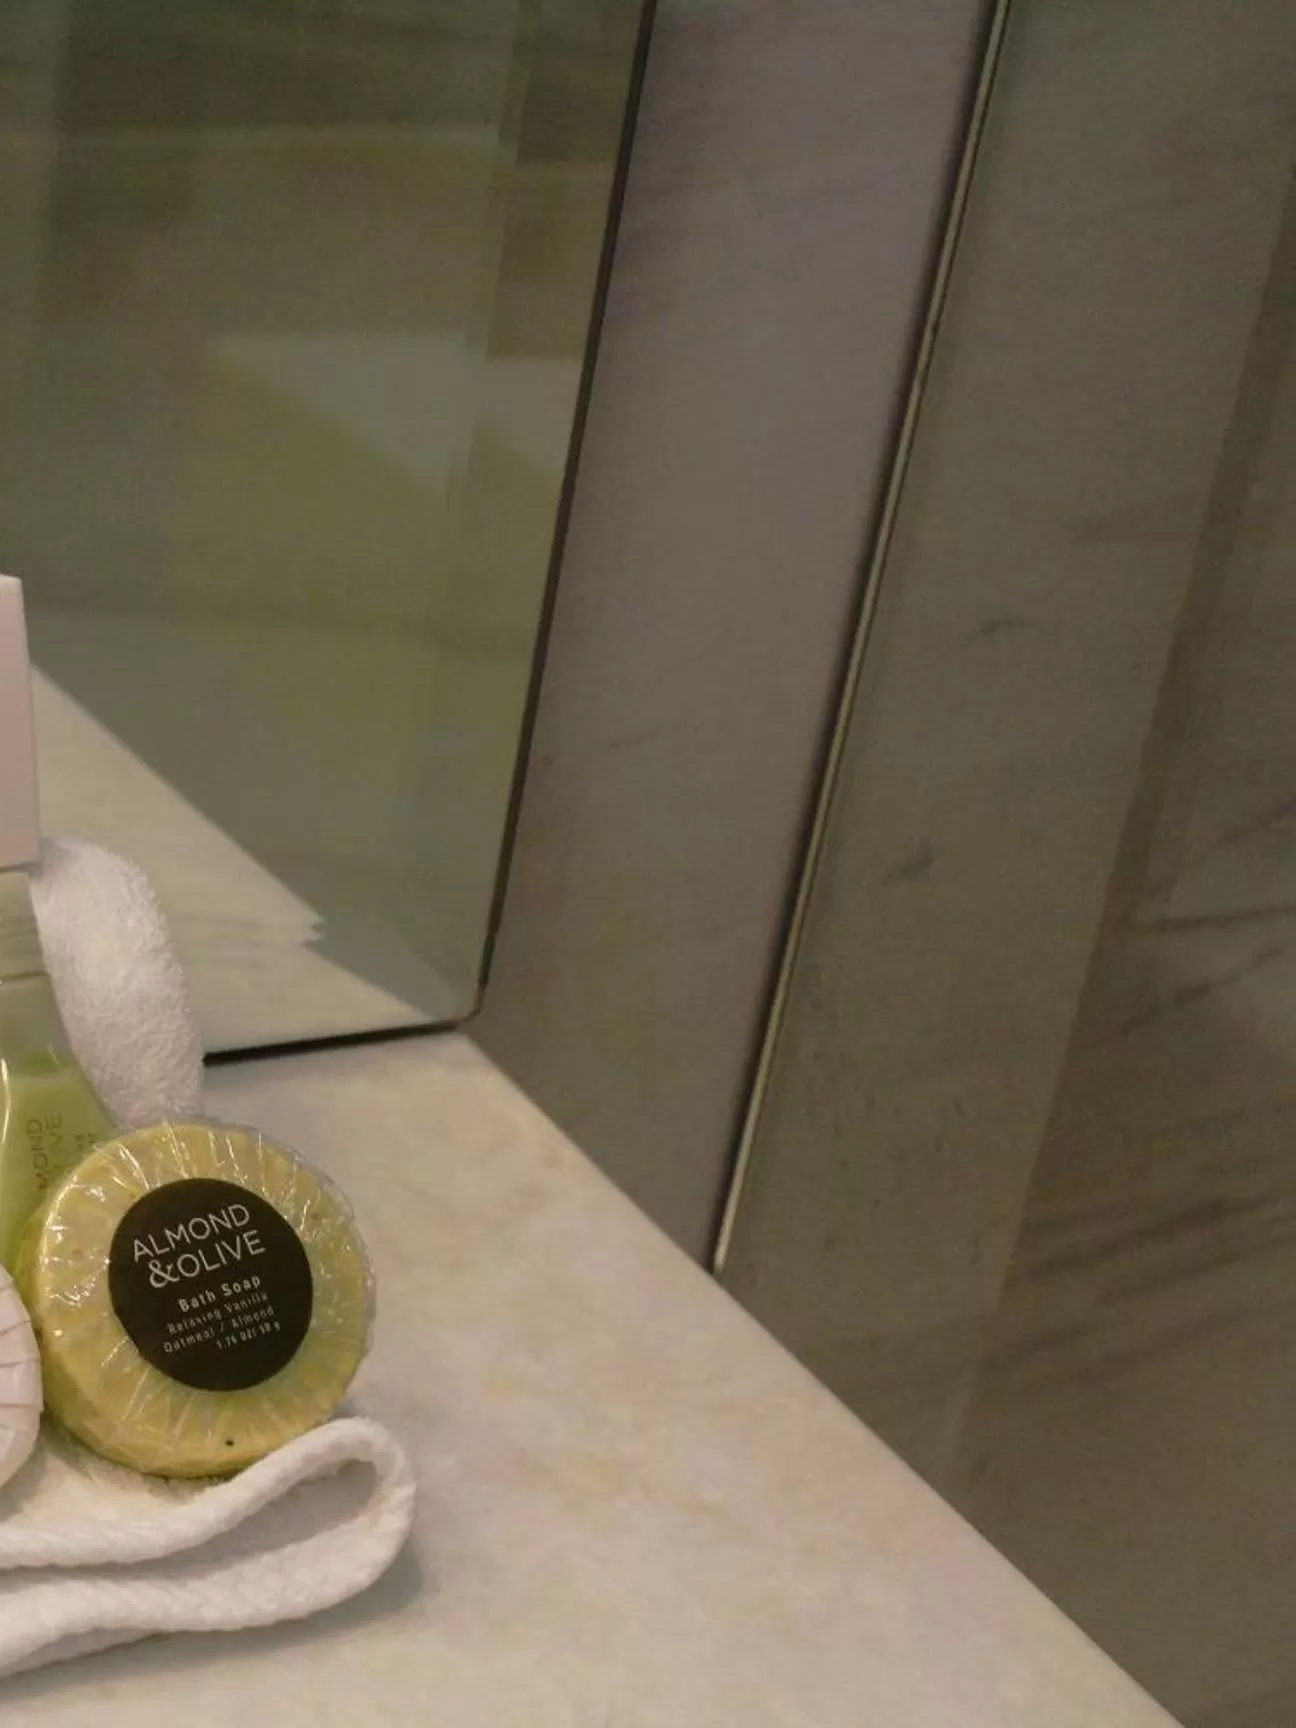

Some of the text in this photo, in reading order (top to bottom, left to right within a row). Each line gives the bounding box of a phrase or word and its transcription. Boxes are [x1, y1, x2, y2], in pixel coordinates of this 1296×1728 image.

[27, 1118, 49, 1191] MOND
[132, 1204, 250, 1263] ALMOND
[148, 1229, 267, 1289] &OLIVE
[177, 1275, 261, 1313] Bath Soap
[223, 1292, 269, 1314] Vanilla
[163, 1327, 216, 1353] Oatmeal
[231, 1305, 275, 1329] Almond
